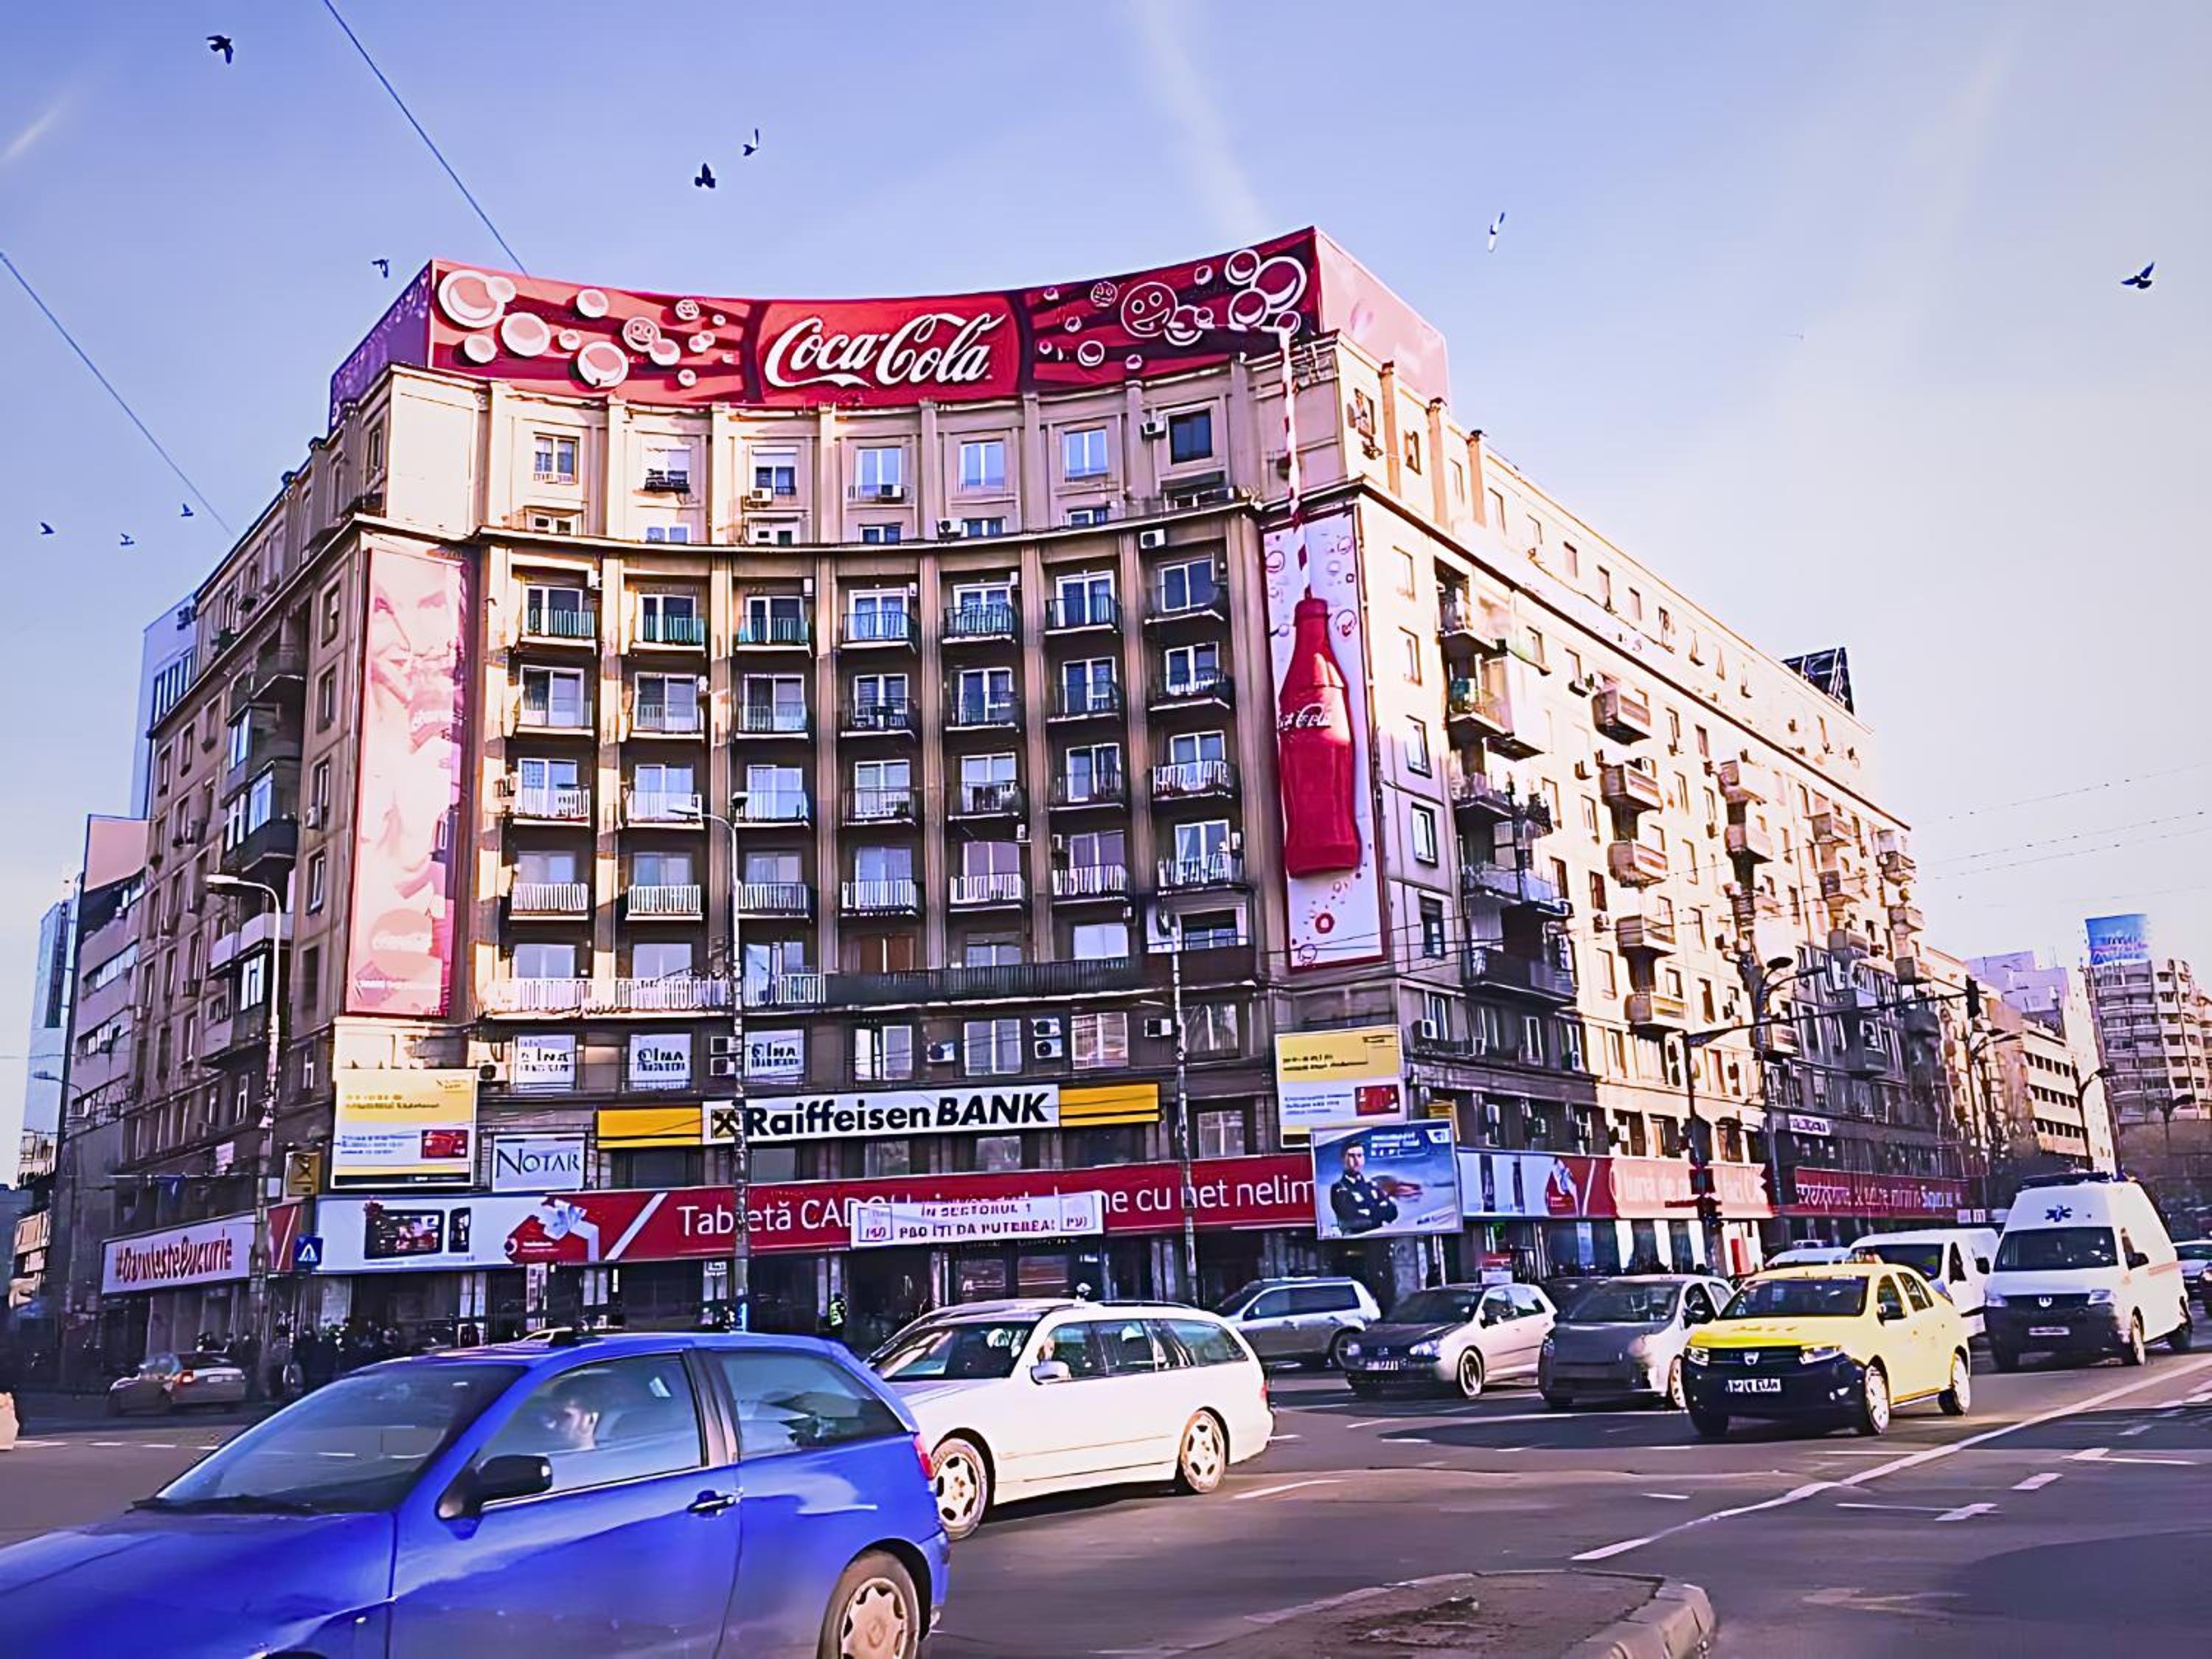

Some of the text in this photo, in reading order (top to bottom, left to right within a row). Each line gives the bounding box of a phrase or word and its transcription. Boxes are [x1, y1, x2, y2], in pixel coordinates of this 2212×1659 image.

[765, 306, 1006, 389] Coca-Cola
[746, 1092, 1050, 1137] Raiffeisen BANK
[1026, 1203, 1032, 1213] 1
[1135, 1187, 1171, 1211] cu
[1180, 1178, 1230, 1209] net
[676, 1200, 792, 1237] Tabetă
